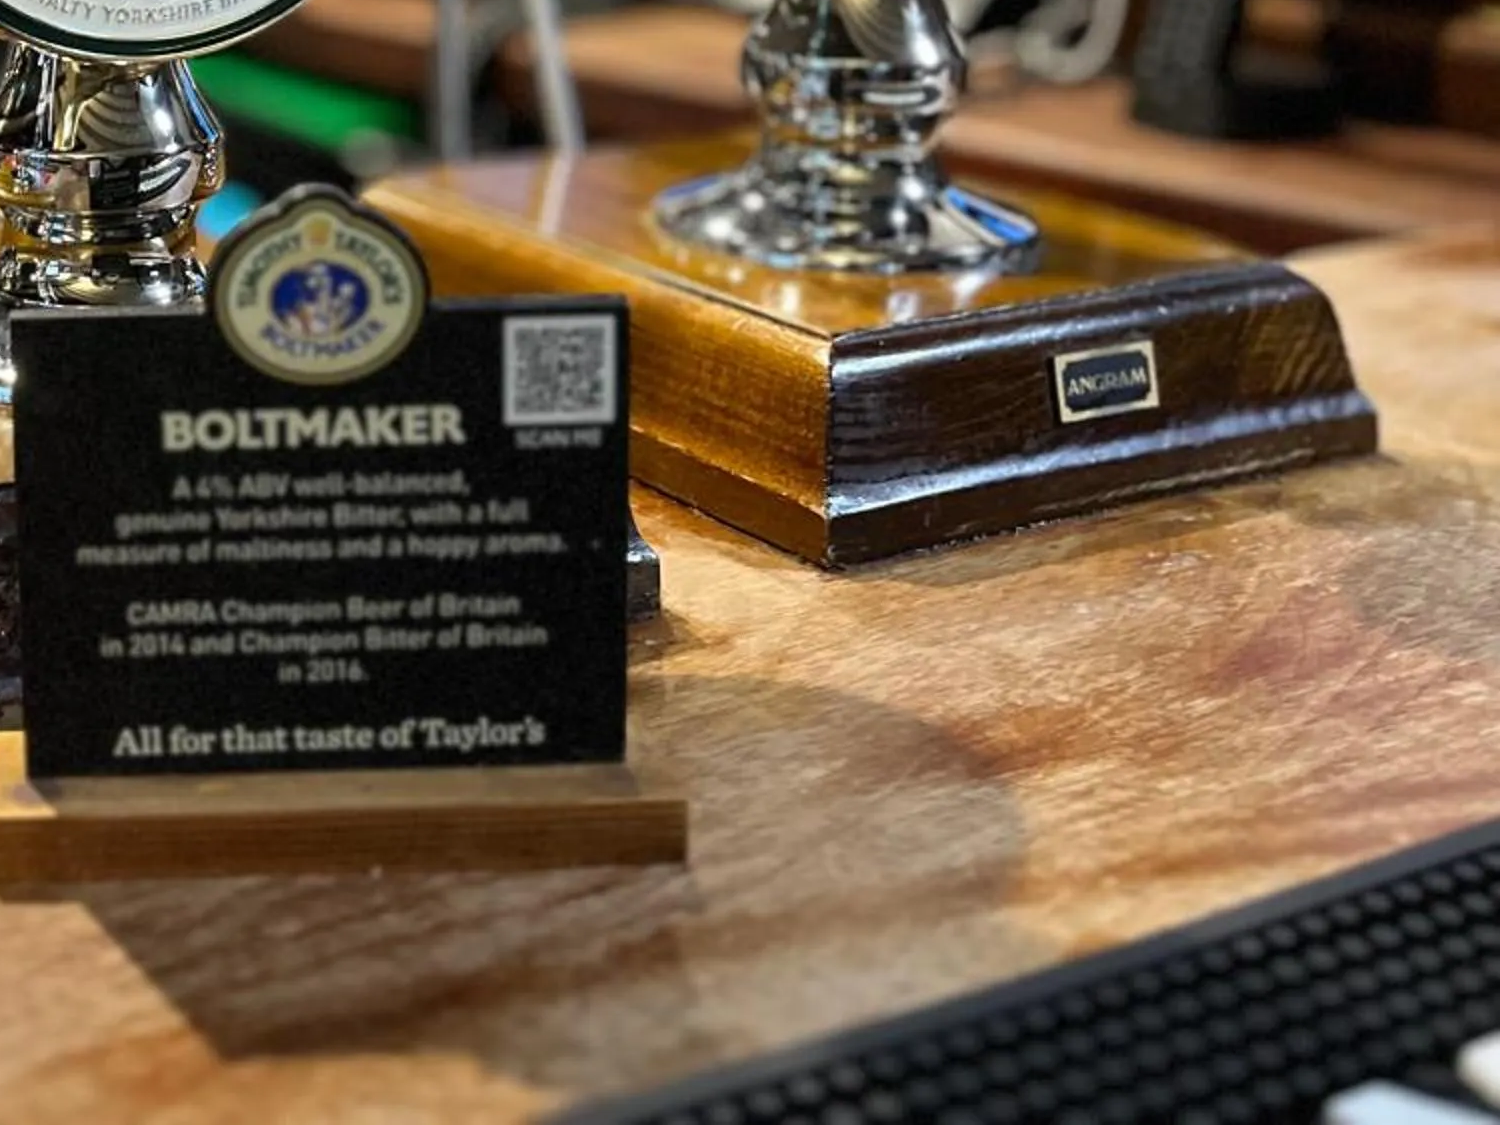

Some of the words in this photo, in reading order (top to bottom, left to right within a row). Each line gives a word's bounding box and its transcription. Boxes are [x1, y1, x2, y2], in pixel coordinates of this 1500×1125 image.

[260, 319, 387, 359] BOLTMAKER
[1067, 365, 1148, 397] ANGRAM
[161, 403, 466, 453] BOLTMAKER
[172, 475, 192, 499] A
[238, 473, 292, 498] ABV
[293, 470, 471, 497] well-balanced,
[113, 513, 211, 539] genuine
[215, 506, 328, 531] Yorkshire
[410, 499, 462, 524] with
[467, 503, 484, 523] a
[488, 497, 530, 523] full
[76, 544, 181, 566] measure
[186, 538, 212, 563] of
[215, 536, 332, 562] maltiness
[337, 533, 383, 559] and
[387, 537, 404, 558] a
[407, 531, 480, 561] hoppy
[484, 532, 568, 555] aroma.
[125, 600, 217, 625] CAMRA
[220, 598, 342, 626] Champion
[346, 594, 404, 622] Beer
[409, 592, 435, 619] of
[439, 591, 522, 618] Britain
[100, 635, 124, 658] in
[128, 632, 186, 658] 2014
[190, 631, 236, 656] and
[239, 628, 360, 655] Champion
[364, 625, 433, 652] Bitter
[437, 622, 462, 649] of
[466, 621, 549, 649] Britain
[277, 661, 301, 684] in
[113, 726, 164, 756] All
[169, 724, 217, 755] for
[222, 722, 288, 753] that
[293, 721, 372, 751] taste
[379, 717, 414, 748] of
[420, 716, 547, 752] Taylor's
